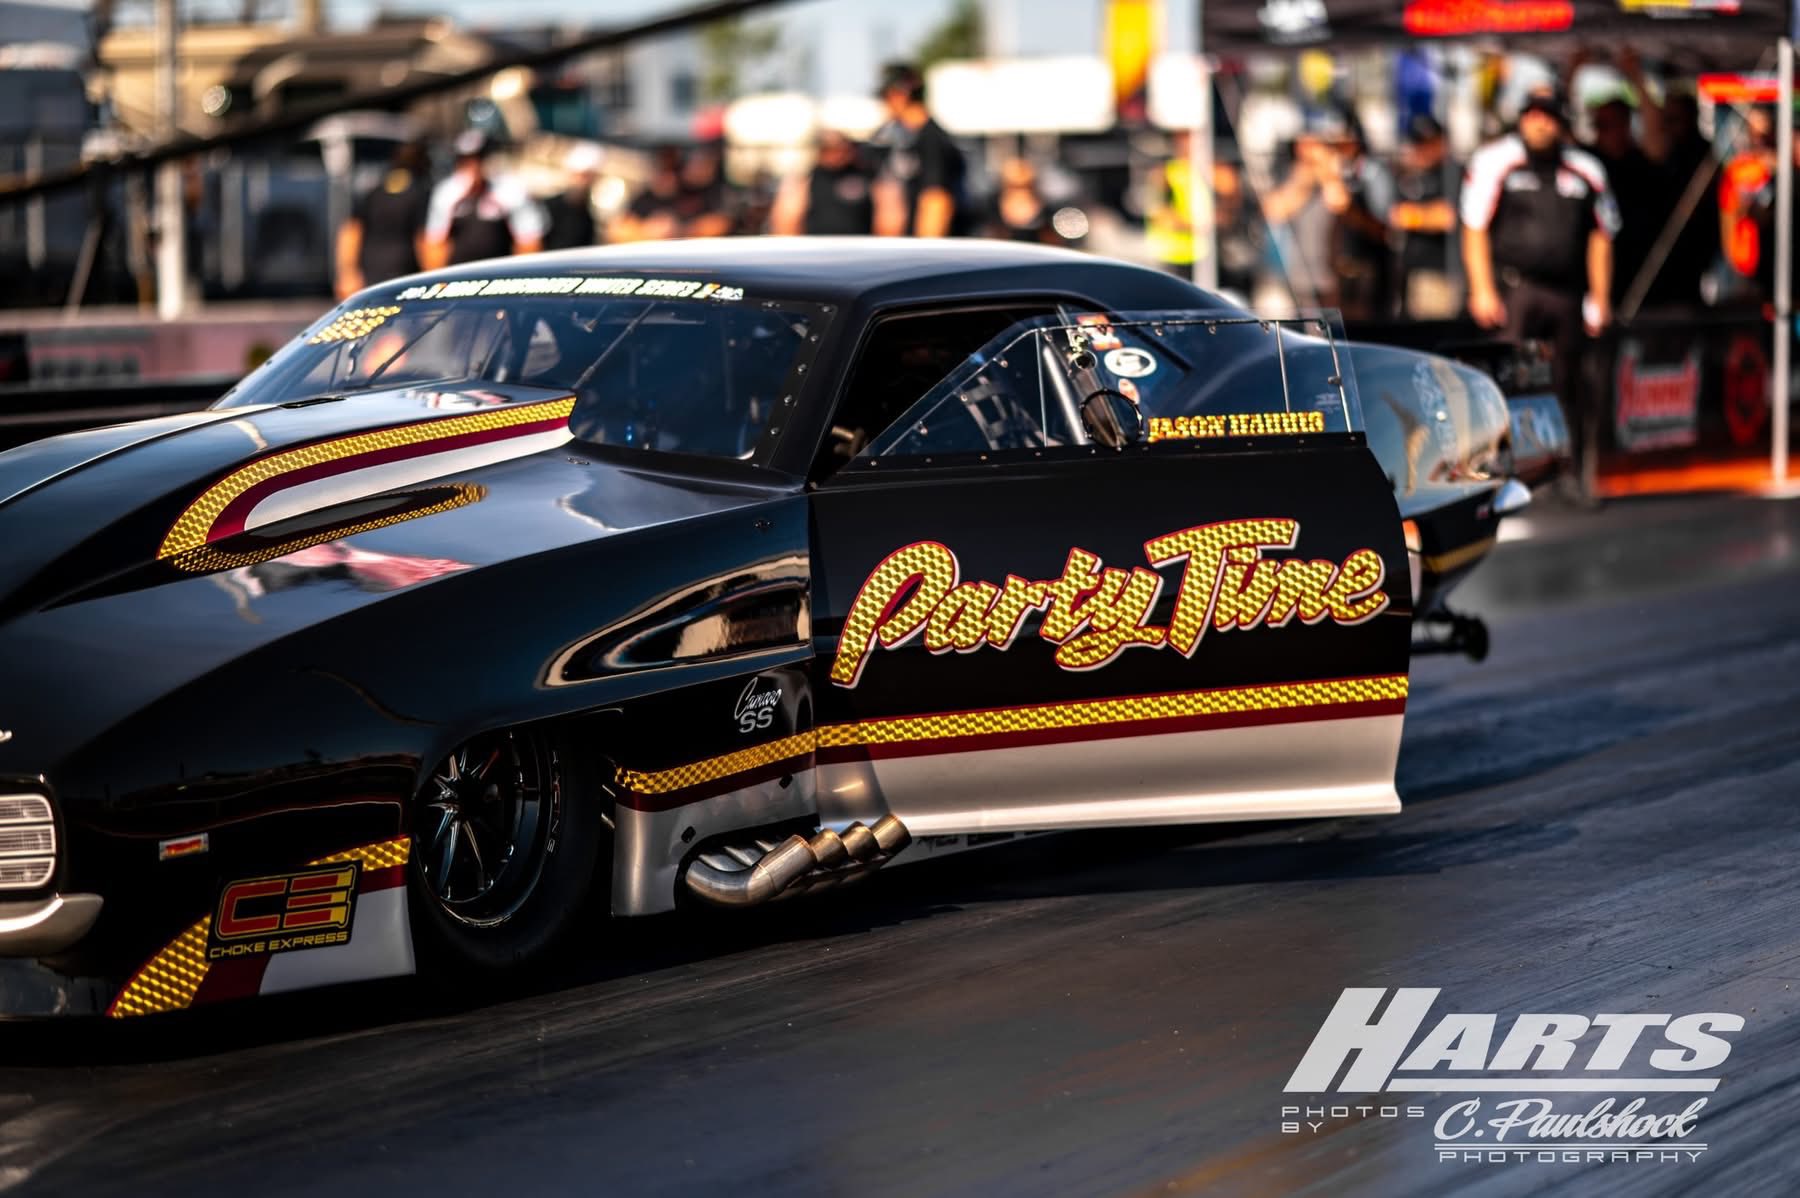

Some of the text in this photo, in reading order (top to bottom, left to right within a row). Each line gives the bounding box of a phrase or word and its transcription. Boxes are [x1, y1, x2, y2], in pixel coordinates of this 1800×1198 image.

[1147, 414, 1227, 443] JASON
[830, 518, 1390, 688] Party Time
[733, 675, 783, 722] Camaro
[738, 705, 774, 734] SS
[209, 930, 348, 959] CHOKE EXPRESS
